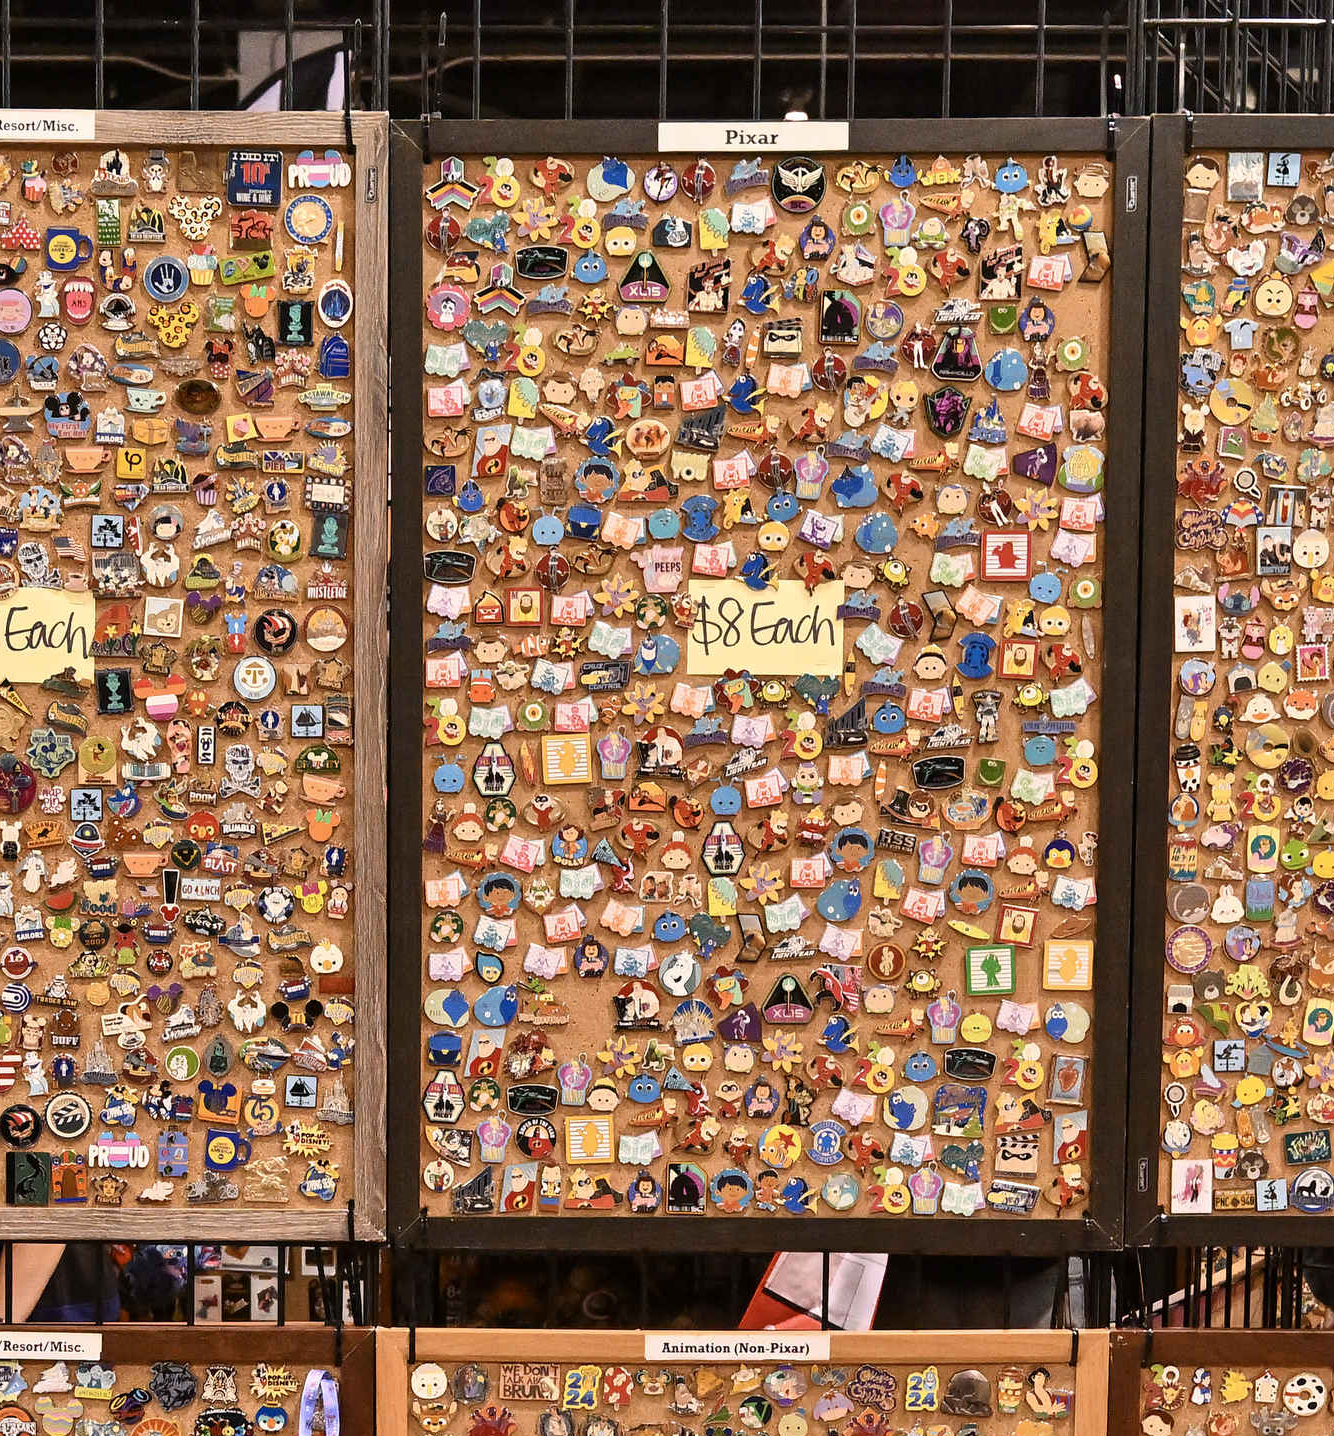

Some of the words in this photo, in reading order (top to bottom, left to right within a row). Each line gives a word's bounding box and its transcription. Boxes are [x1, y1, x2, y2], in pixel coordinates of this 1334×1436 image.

[725, 129, 778, 144] Pixar
[241, 152, 262, 163] DID
[264, 153, 279, 163] IT!
[655, 561, 682, 575] PEEPS
[307, 588, 348, 599] MISTLETOE
[693, 595, 745, 656] $8
[751, 602, 835, 646] Each
[5, 606, 89, 660] Each
[221, 823, 256, 835] RUMBLE
[205, 858, 238, 874] BLAST
[186, 914, 224, 931] Everest
[662, 1342, 730, 1353] Animation
[735, 1342, 810, 1355] (Non-Pixar)
